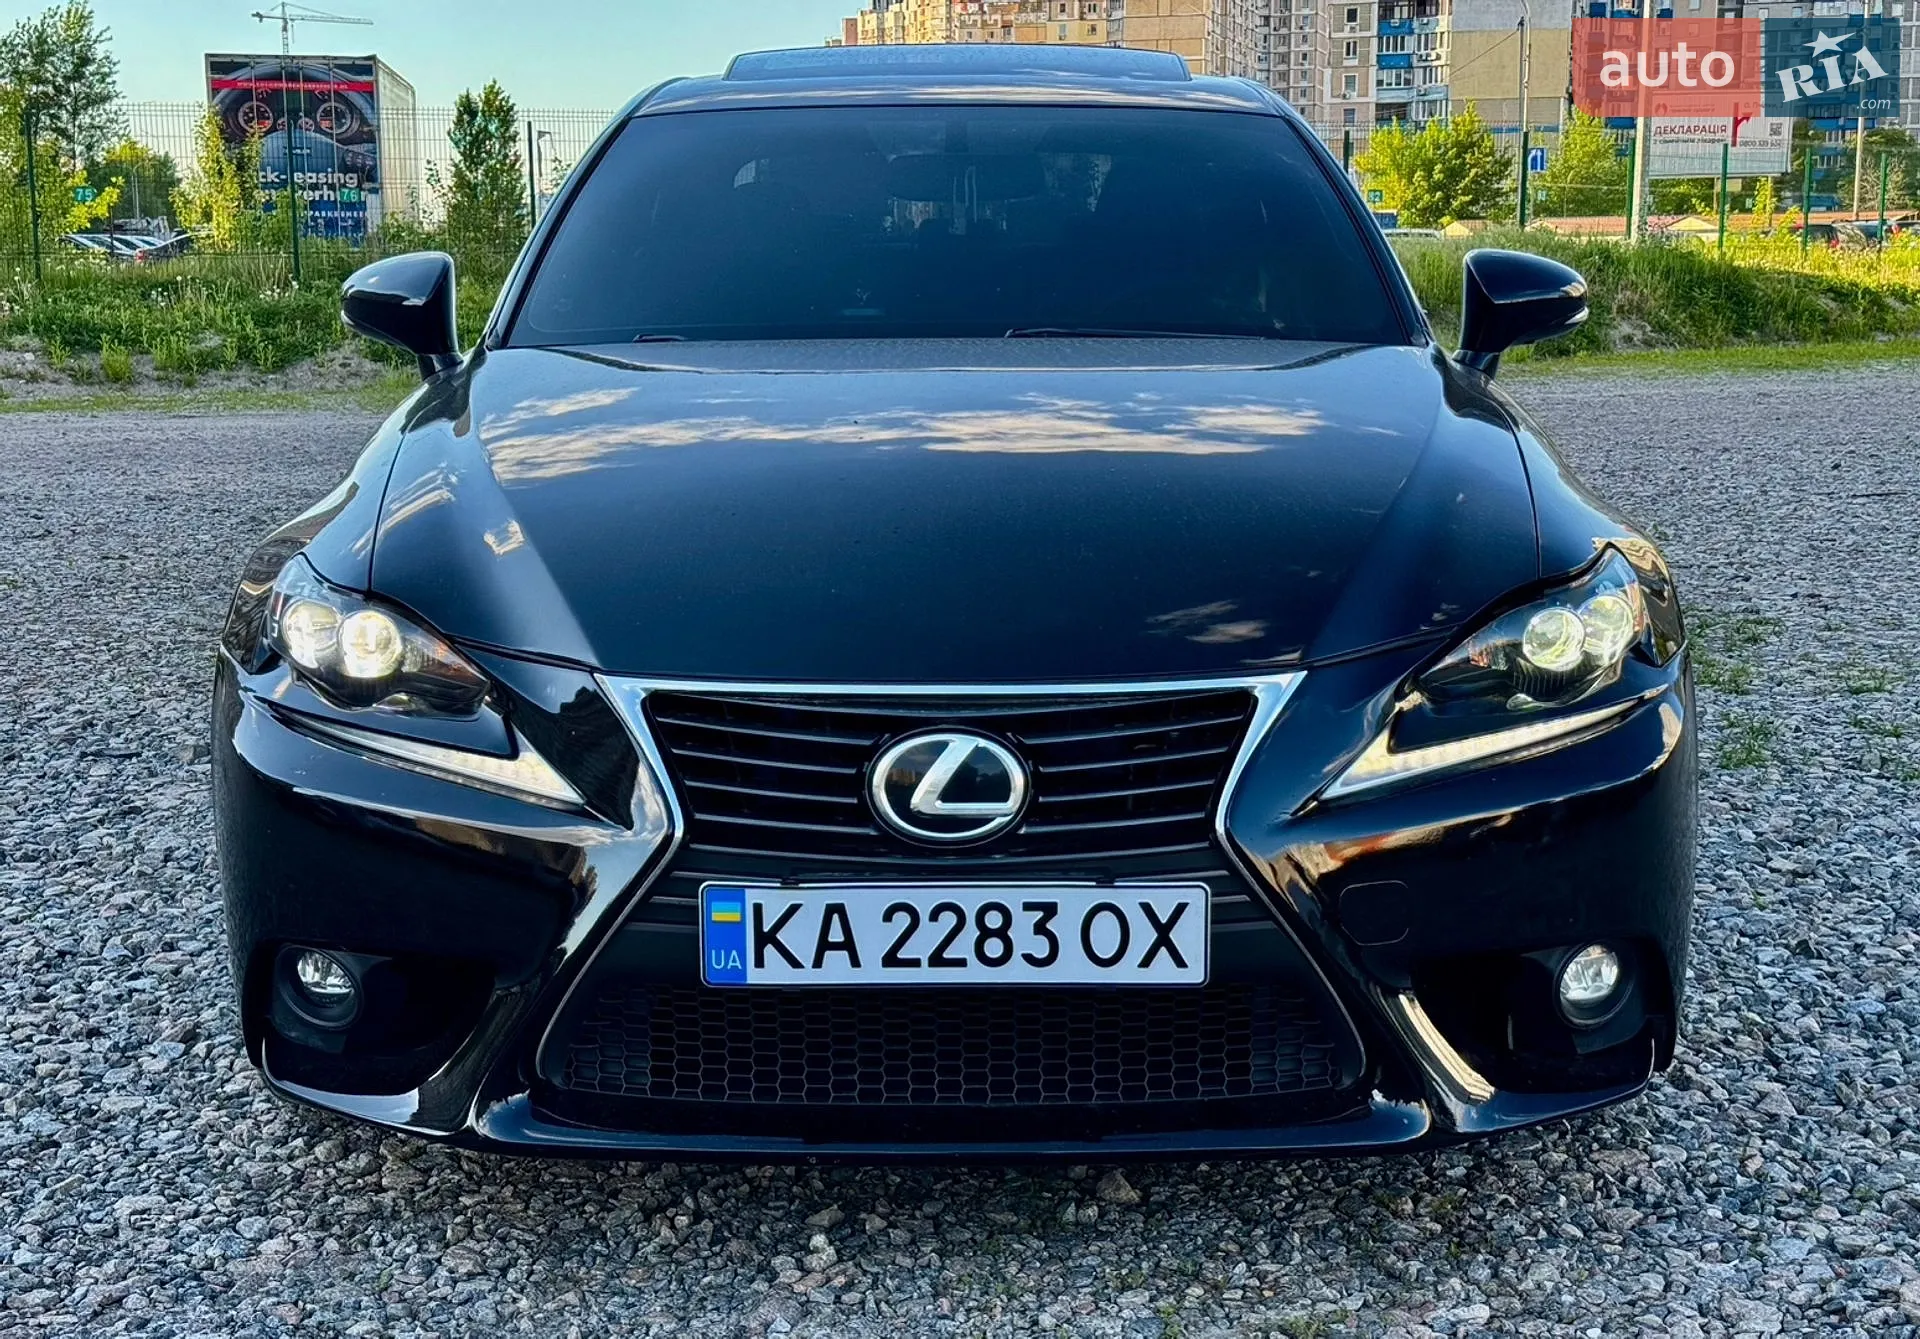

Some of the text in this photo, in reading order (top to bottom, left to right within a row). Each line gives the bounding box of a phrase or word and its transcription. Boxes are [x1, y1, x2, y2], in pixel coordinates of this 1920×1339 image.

[1653, 124, 1727, 136] ДЕКЛАРАЦІЯ
[76, 188, 93, 201] 75
[341, 188, 358, 202] 76
[752, 902, 1190, 969] KA 2283 OX
[711, 949, 742, 970] UA
